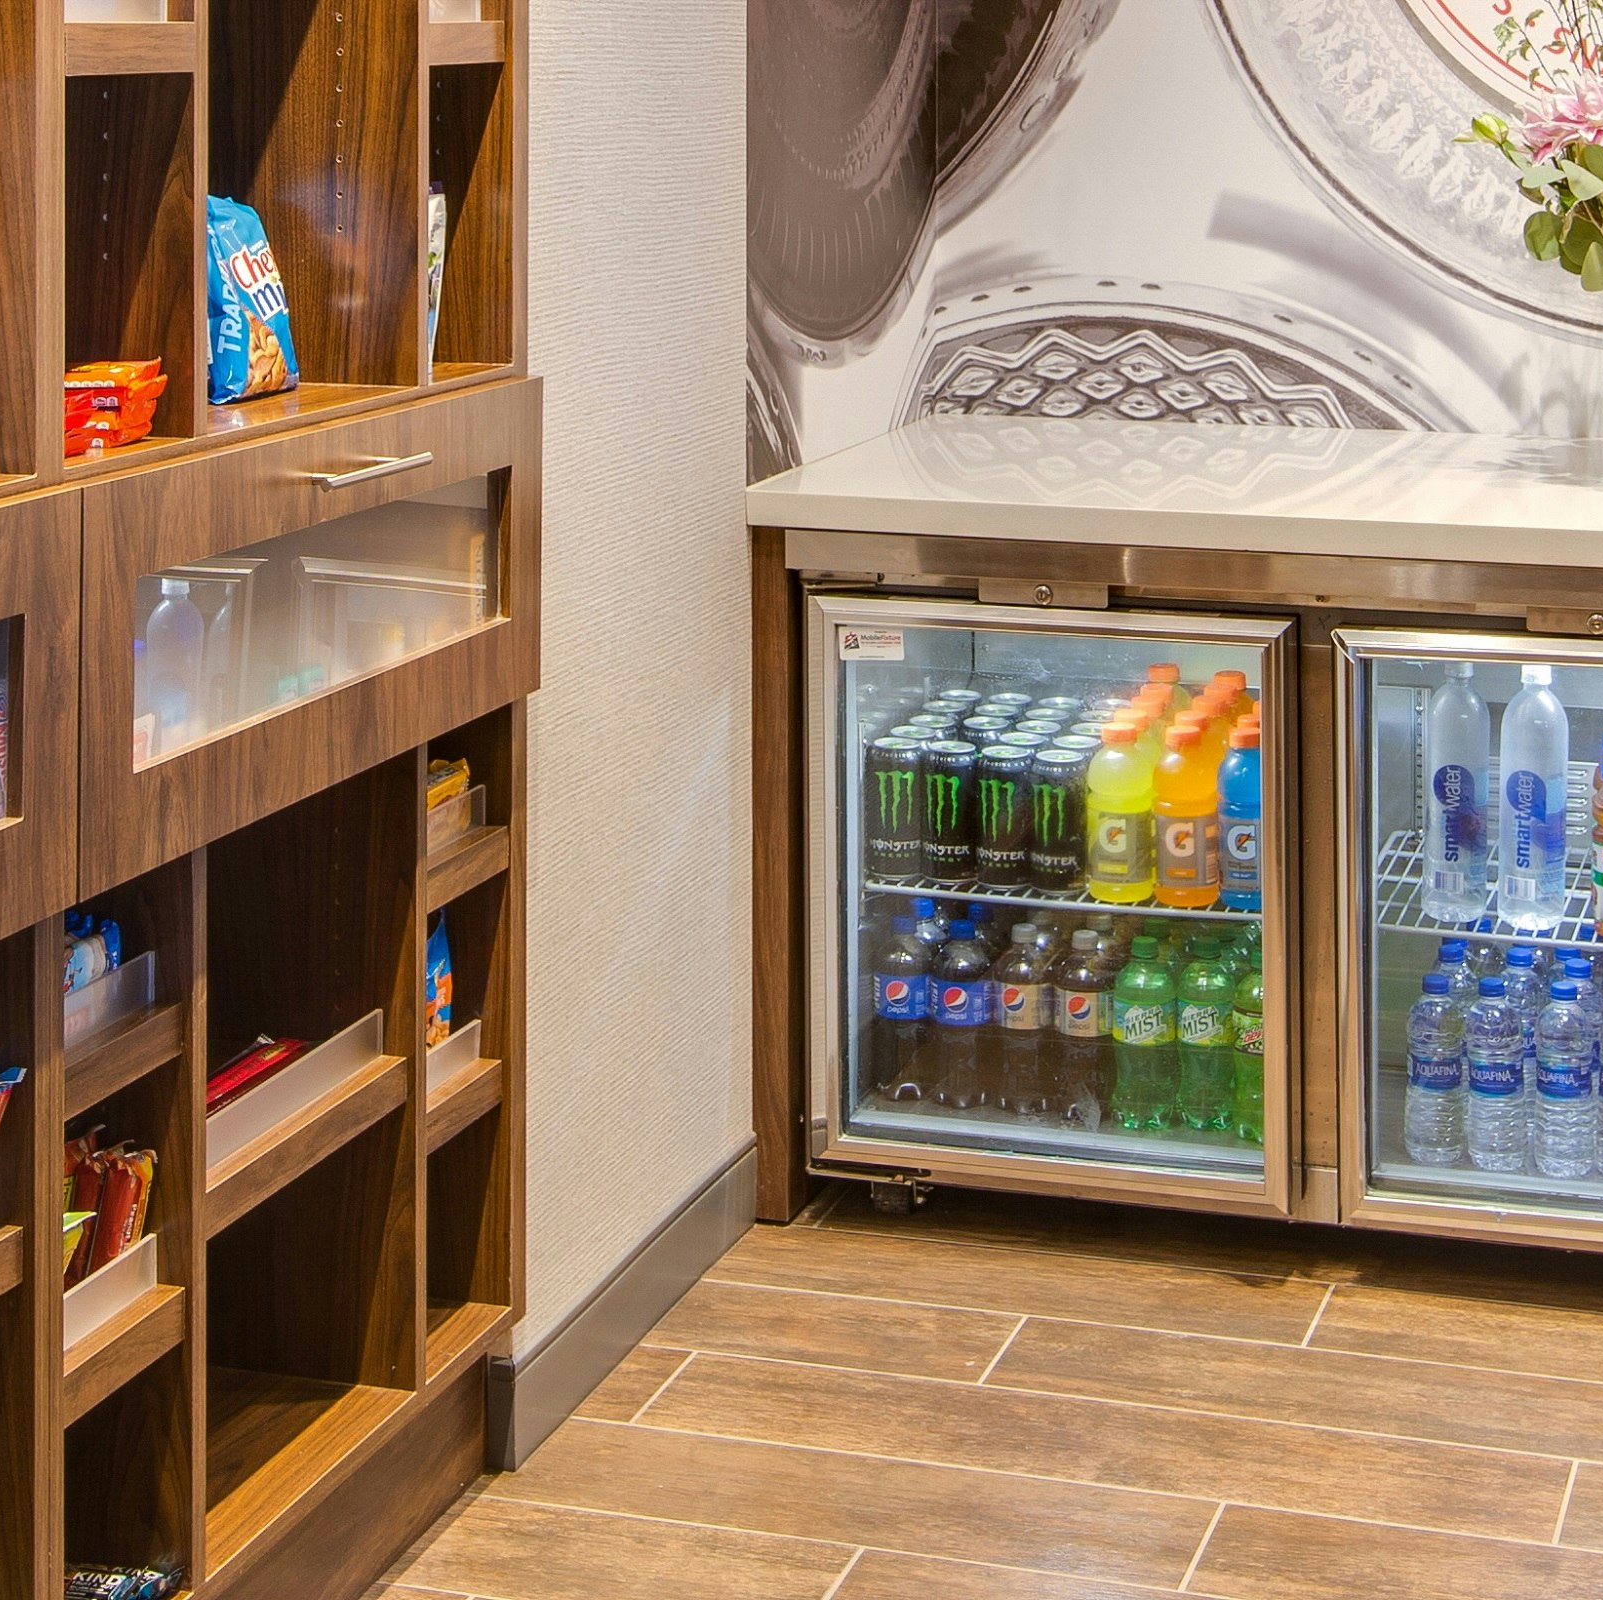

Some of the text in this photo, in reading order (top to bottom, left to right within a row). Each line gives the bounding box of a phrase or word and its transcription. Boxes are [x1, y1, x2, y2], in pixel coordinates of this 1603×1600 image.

[1514, 771, 1535, 869] smartwater
[1165, 822, 1195, 857] G
[1227, 825, 1256, 860] G
[886, 1005, 910, 1016] pepsi
[945, 1012, 968, 1022] pepsi
[1125, 1006, 1163, 1023] SIERRA
[1182, 1006, 1219, 1023] SIERRA
[1124, 1012, 1162, 1040] MIST
[1181, 1012, 1218, 1039] MIST
[1415, 1063, 1459, 1077] AQUAFINA
